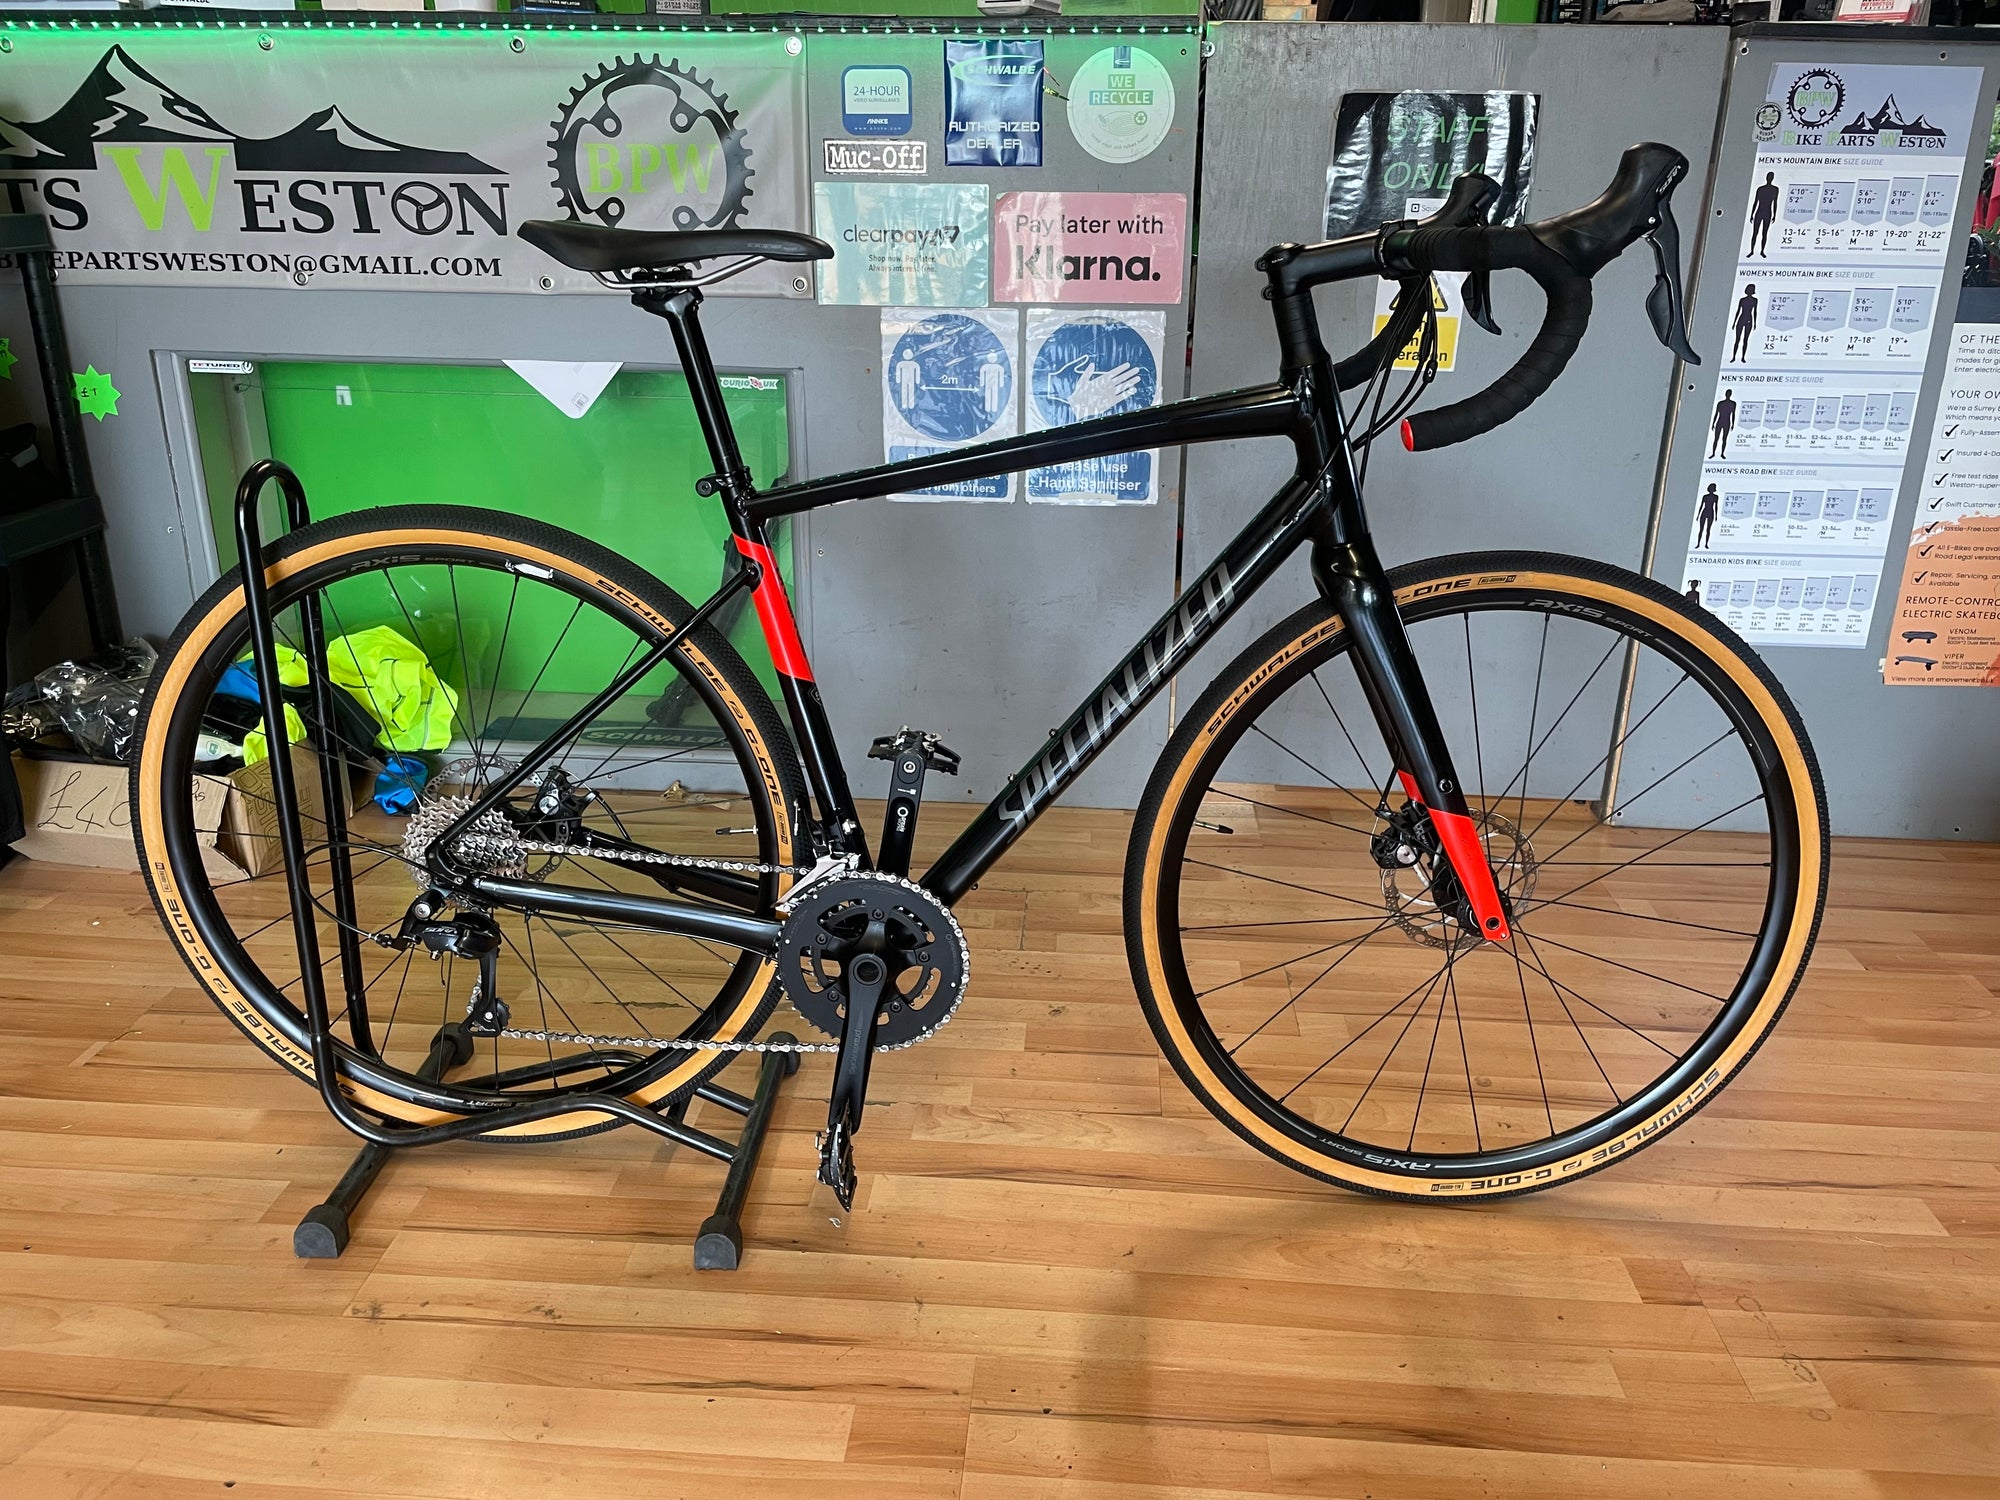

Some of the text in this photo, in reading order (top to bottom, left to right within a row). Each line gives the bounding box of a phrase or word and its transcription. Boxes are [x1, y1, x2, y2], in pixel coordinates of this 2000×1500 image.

[966, 65, 1036, 75] SCHWALBE
[1110, 75, 1132, 88] WE
[853, 86, 901, 96] 24-HOUR
[1092, 91, 1151, 104] RECYCLE
[1795, 91, 1837, 107] BPW
[948, 121, 1040, 132] AUTHORIZED
[1387, 115, 1490, 144] STAFF
[1782, 130, 1947, 149] BIKE PARTS WESTON
[829, 145, 923, 170] Muc-Off
[1758, 156, 1782, 164] MEN'S
[1783, 157, 1823, 165] MOUNTAIN
[1843, 158, 1860, 166] SIZE
[582, 142, 720, 194] BPW
[1016, 214, 1164, 237] Pay later with
[842, 223, 929, 251] clearpay
[0, 251, 502, 277] BEPARTSWESTON@GMAIL.COM
[868, 254, 886, 263] Shop
[1015, 244, 1161, 282] Klarna.
[1739, 269, 1774, 277] WOMEN'S
[1775, 270, 1815, 278] MOUNTAIN
[1852, 271, 1875, 279] GUIDE
[1960, 334, 1976, 344] OF
[941, 375, 958, 385] 2m
[1950, 390, 1981, 399] YOUR
[1974, 405, 1996, 413] Surrey
[1103, 462, 1128, 474] use
[1705, 467, 1739, 475] WOMEN'S
[1761, 468, 1778, 476] BIKE
[1796, 469, 1818, 477] GUIDE
[962, 483, 996, 494] others
[1038, 476, 1141, 492] Hand Sanitiser
[1689, 557, 1727, 565] STANDARD
[1746, 558, 1762, 566] BIKE
[1780, 559, 1802, 567] GUIDE
[1902, 609, 1953, 619] ELECTRIC
[1604, 616, 1653, 638] SPORT
[1207, 578, 1471, 736] SCHWALBE -ONE
[998, 561, 1236, 845] SPECIALIZED
[744, 728, 783, 807] G-ONE
[166, 898, 213, 971] G-ONE
[1470, 1068, 1721, 1191] SCHWALBE G-ONE
[1318, 1137, 1363, 1158] SPORT
